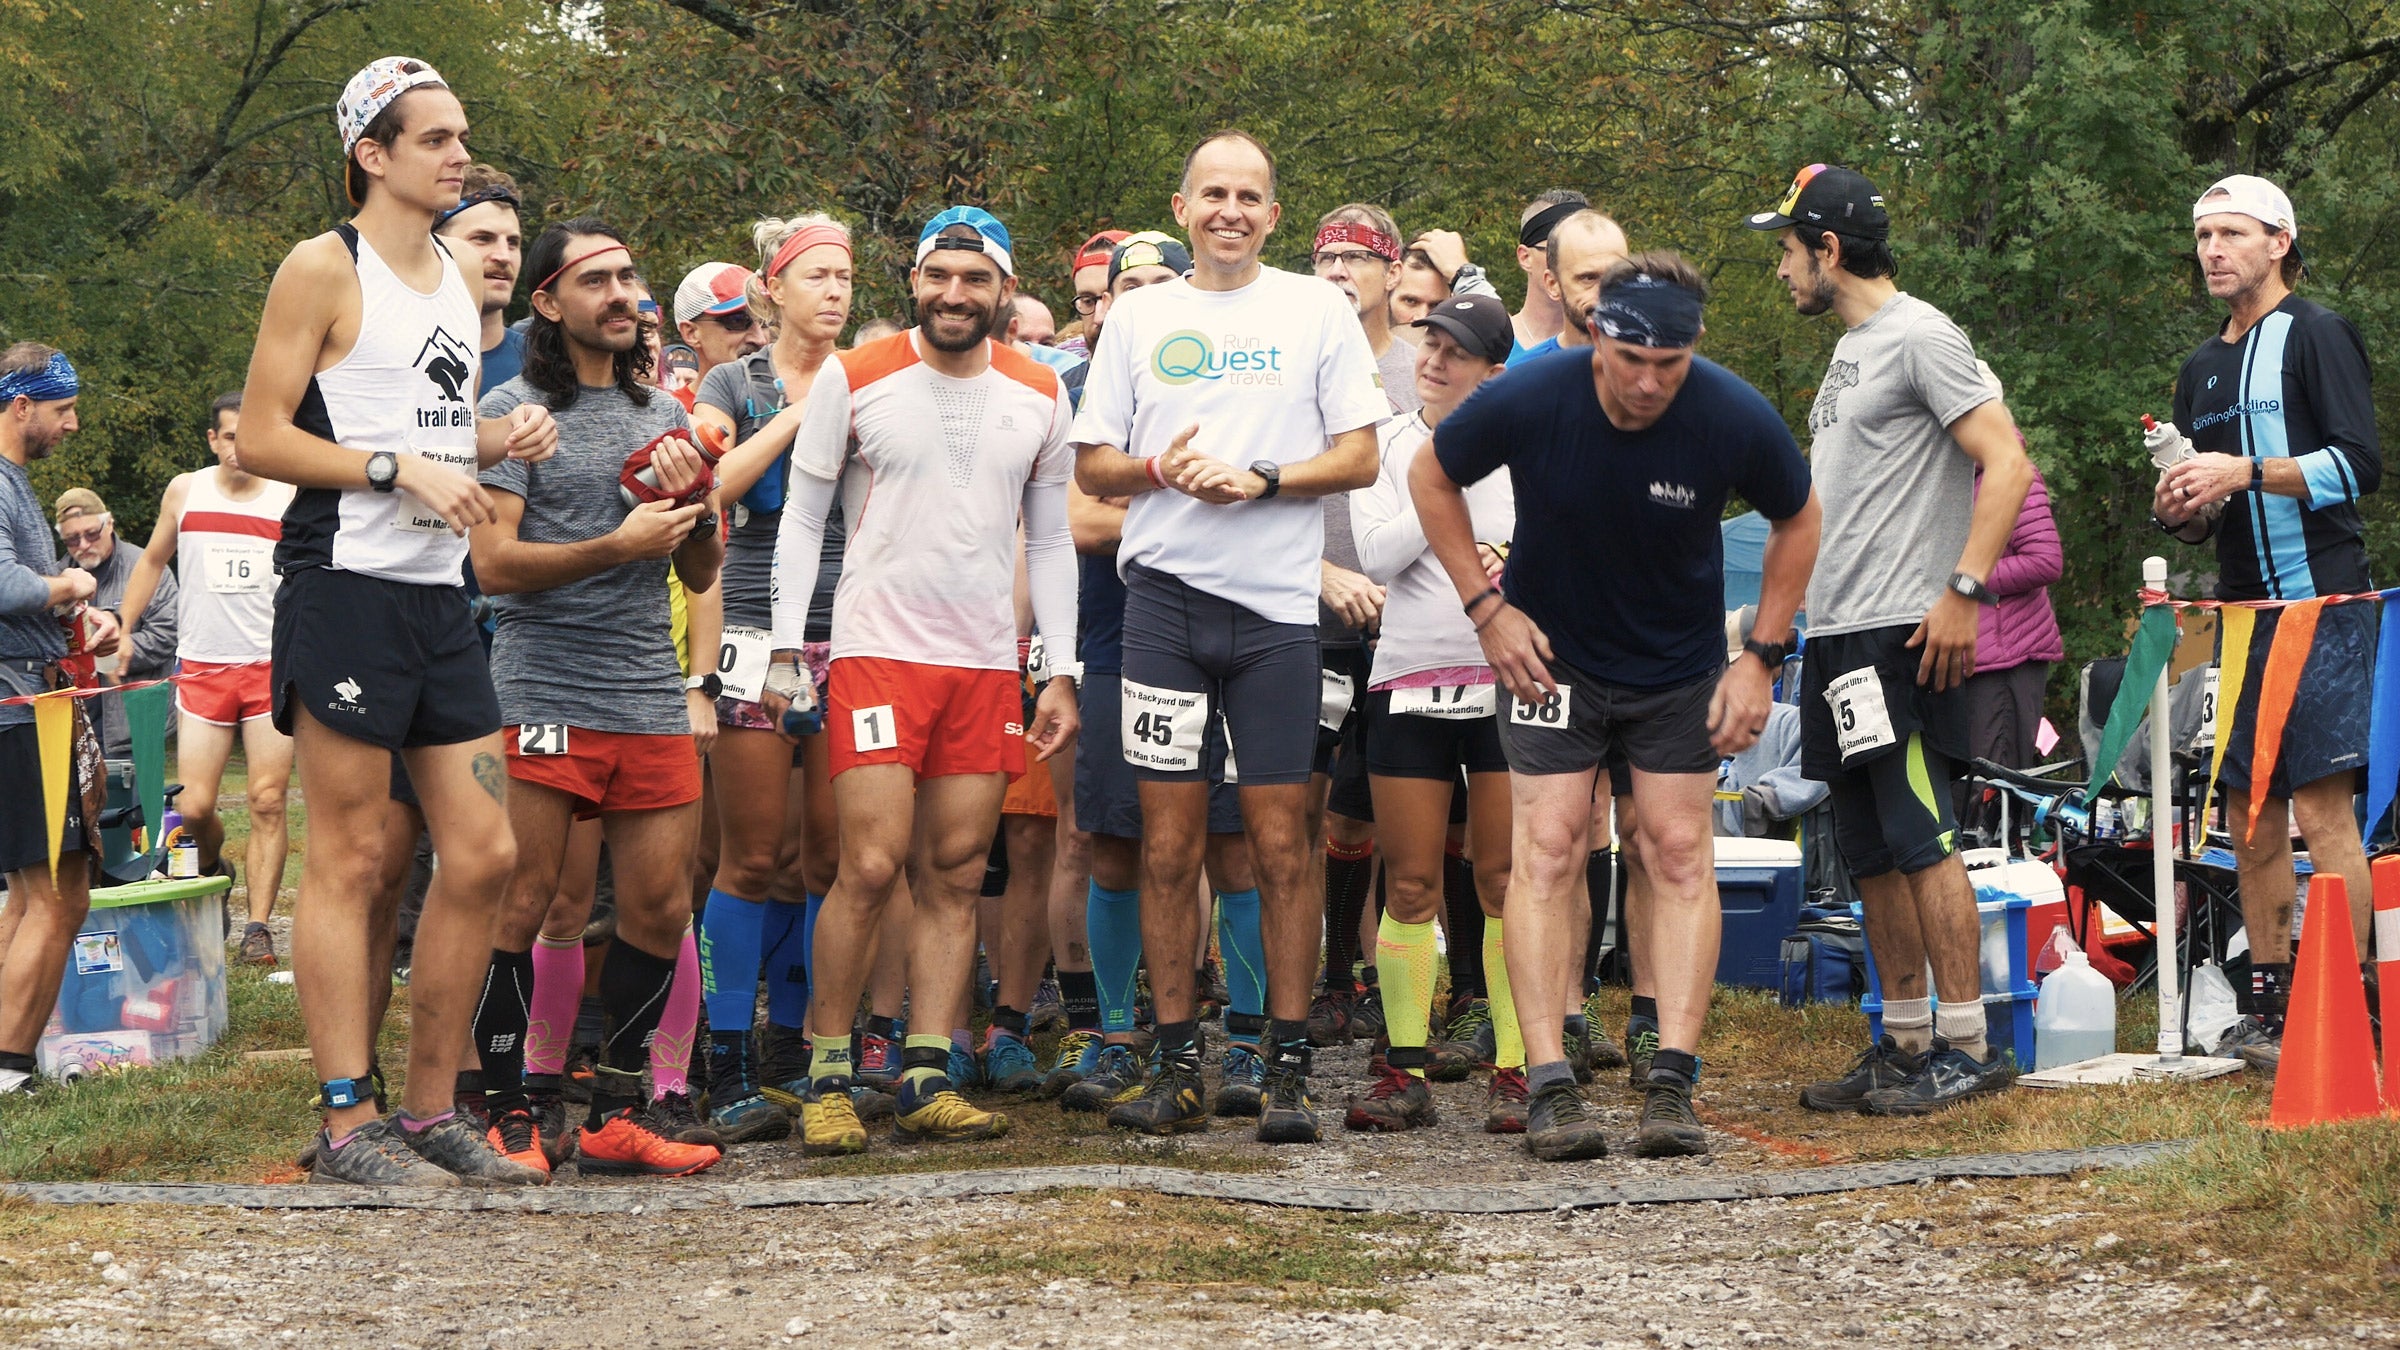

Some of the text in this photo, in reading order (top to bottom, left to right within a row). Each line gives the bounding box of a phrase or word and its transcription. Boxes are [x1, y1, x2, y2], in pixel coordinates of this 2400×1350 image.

[1224, 334, 1260, 349] Run
[1158, 336, 1281, 380] Quest
[1229, 372, 1283, 386] travel
[416, 406, 472, 428] trail elite
[412, 516, 431, 528] Last
[225, 559, 250, 578] 16
[1849, 675, 1869, 688] Ultra
[327, 702, 367, 714] ELITE
[1137, 692, 1177, 707] Backyard
[1178, 698, 1196, 708] Ultra
[1516, 690, 1562, 723] 58
[863, 712, 881, 744] 1
[1133, 710, 1173, 747] 45
[523, 723, 565, 754] 21
[1846, 733, 1879, 750] Standing
[1133, 750, 1149, 762] Man
[1150, 753, 1188, 767] Standing
